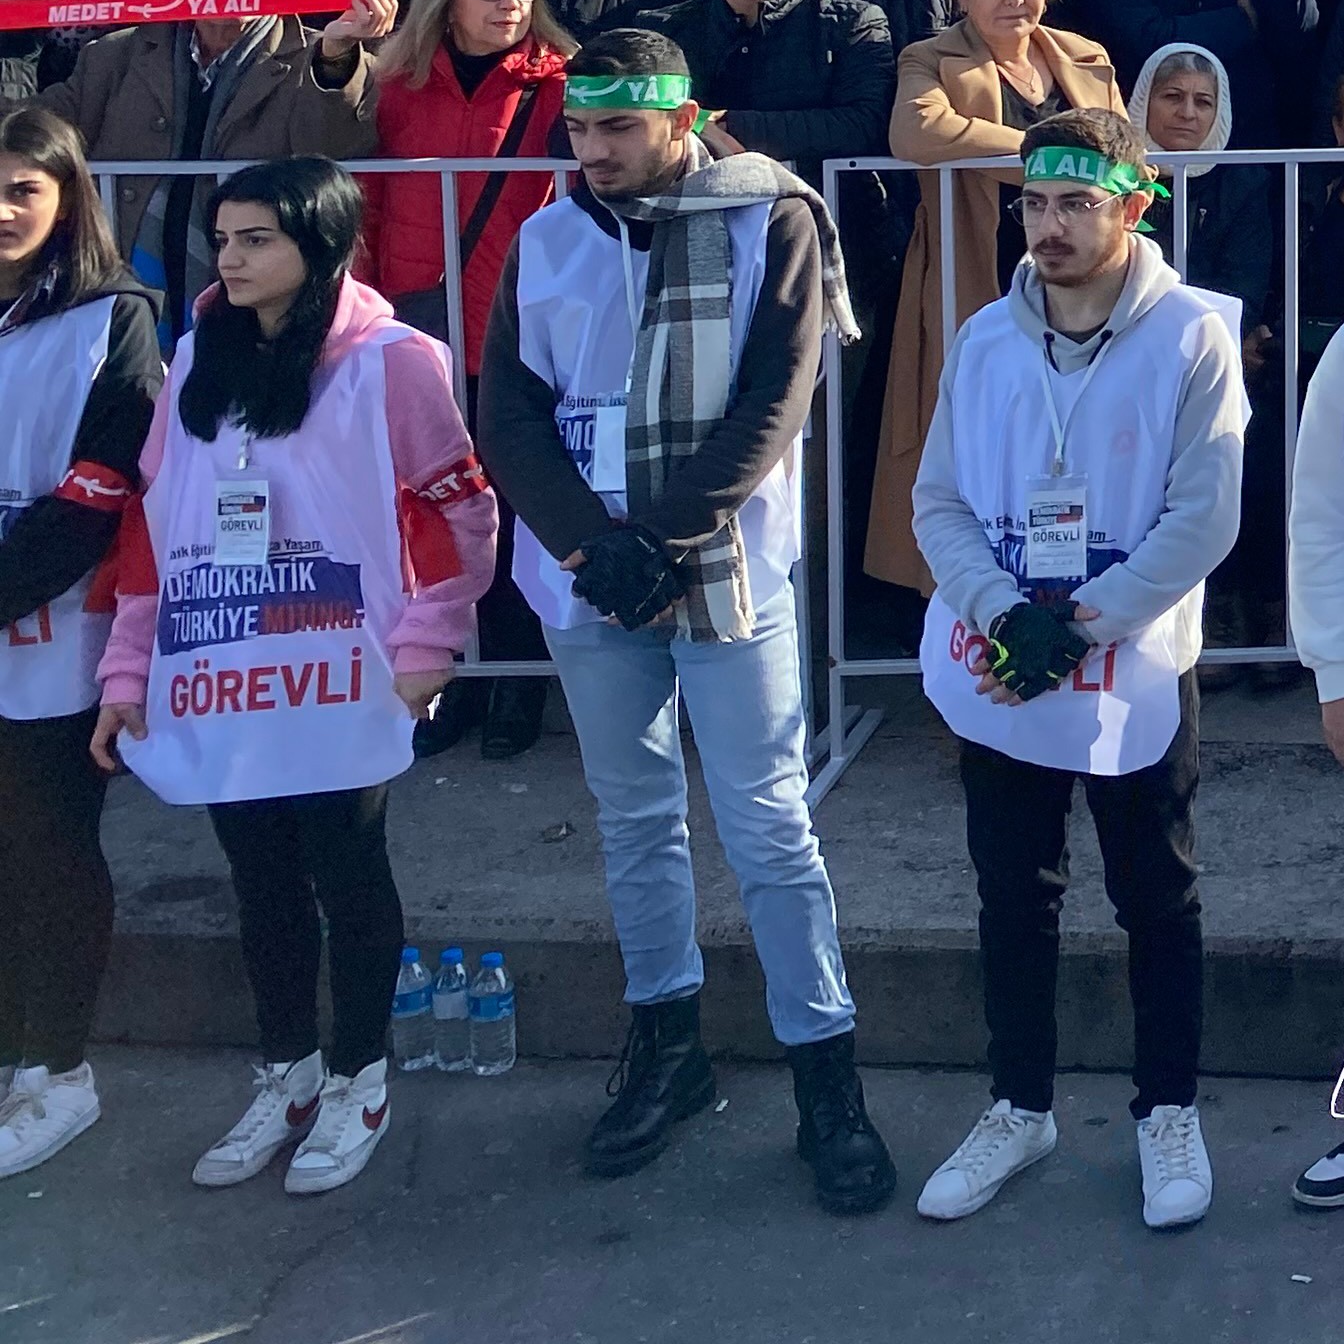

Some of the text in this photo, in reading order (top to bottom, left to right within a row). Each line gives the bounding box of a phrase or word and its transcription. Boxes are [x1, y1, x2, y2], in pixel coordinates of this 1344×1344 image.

[48, 0, 126, 25] MEDET
[627, 75, 659, 102] YÂ
[220, 516, 264, 532] GÖREVLİ
[1032, 528, 1080, 544] GÖREVLİ
[166, 555, 318, 604] DEMOKRATİK
[170, 601, 259, 644] TÜRKİYE
[170, 646, 362, 719] GÖREVLİ
